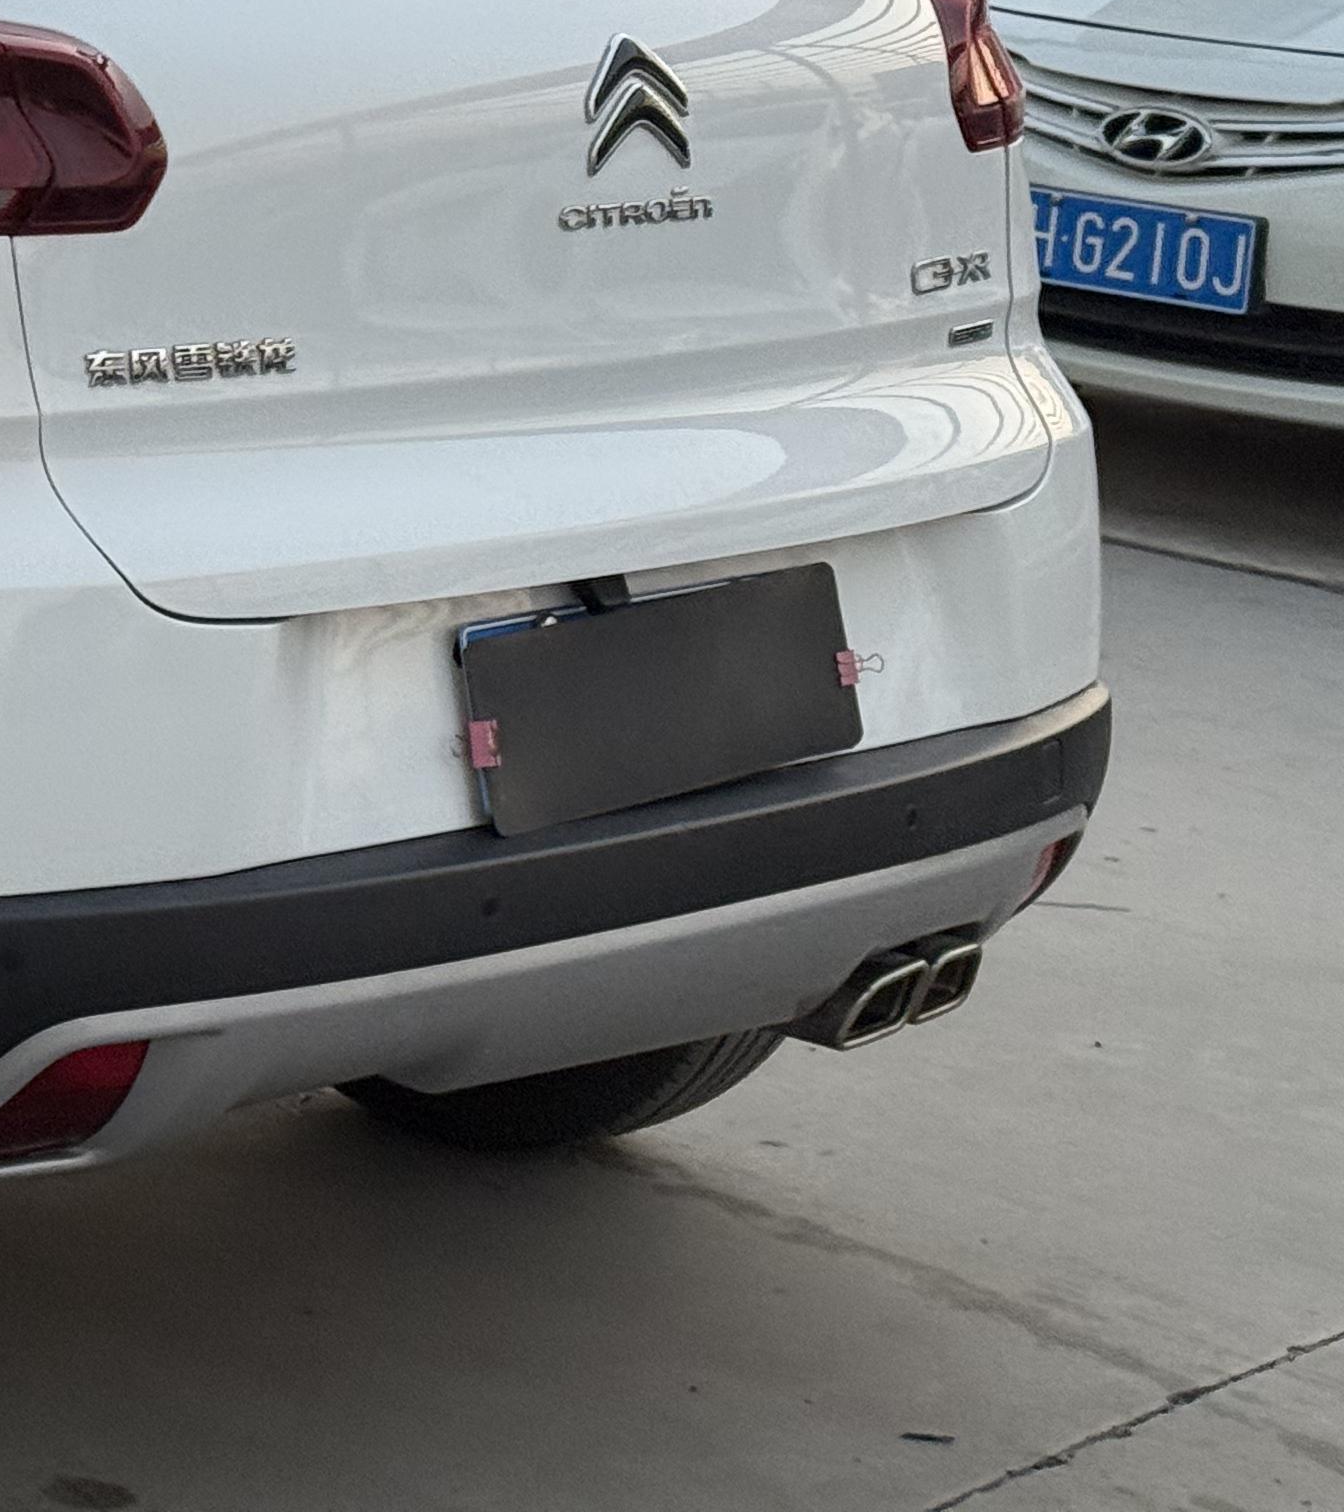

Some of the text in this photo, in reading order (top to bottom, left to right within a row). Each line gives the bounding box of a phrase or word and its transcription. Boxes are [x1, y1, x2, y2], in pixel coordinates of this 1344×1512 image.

[85, 337, 296, 388] 东风雪铁龙
